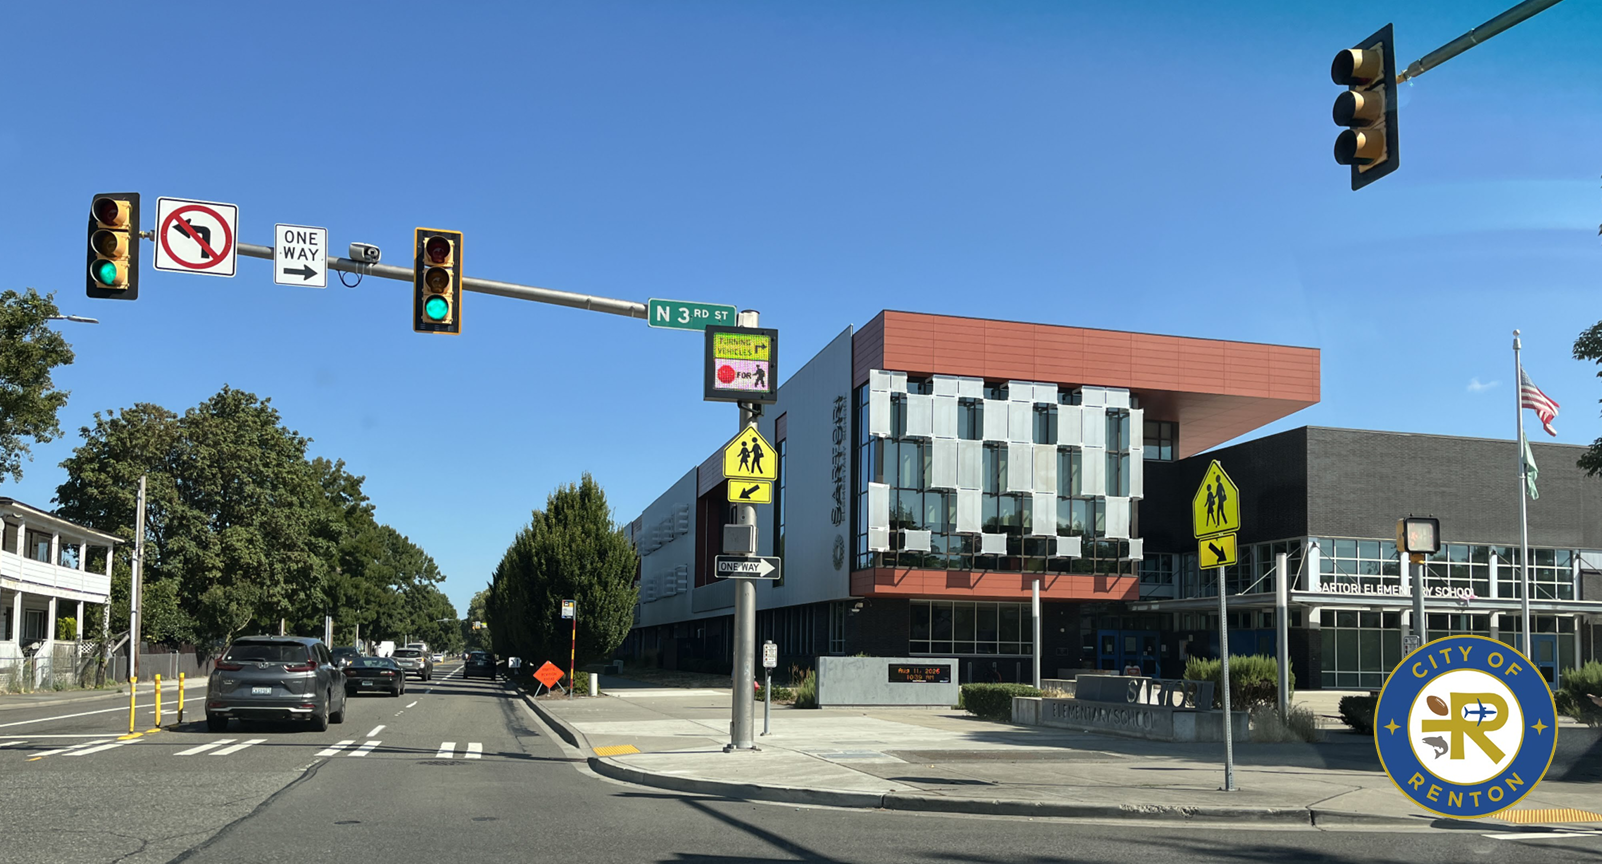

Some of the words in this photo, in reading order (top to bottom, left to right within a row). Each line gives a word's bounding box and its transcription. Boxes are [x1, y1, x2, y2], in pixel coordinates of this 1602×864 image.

[285, 230, 318, 246] ONE
[283, 246, 319, 261] WAY
[656, 305, 670, 322] N
[677, 307, 710, 324] 3RD
[714, 310, 729, 320] ST
[719, 337, 752, 346] TURNING
[717, 347, 753, 357] VEHICLES
[736, 371, 752, 379] FOR
[831, 395, 844, 527] SARTORI
[720, 561, 739, 572] ONE
[741, 561, 760, 572] WAY
[1314, 582, 1362, 594] SARTORI
[1364, 583, 1434, 596] ELEMENTRY
[1435, 586, 1475, 598] SCHOOL
[1052, 703, 1112, 723] ELEMENTARY
[1113, 708, 1155, 730] SCHOOL
